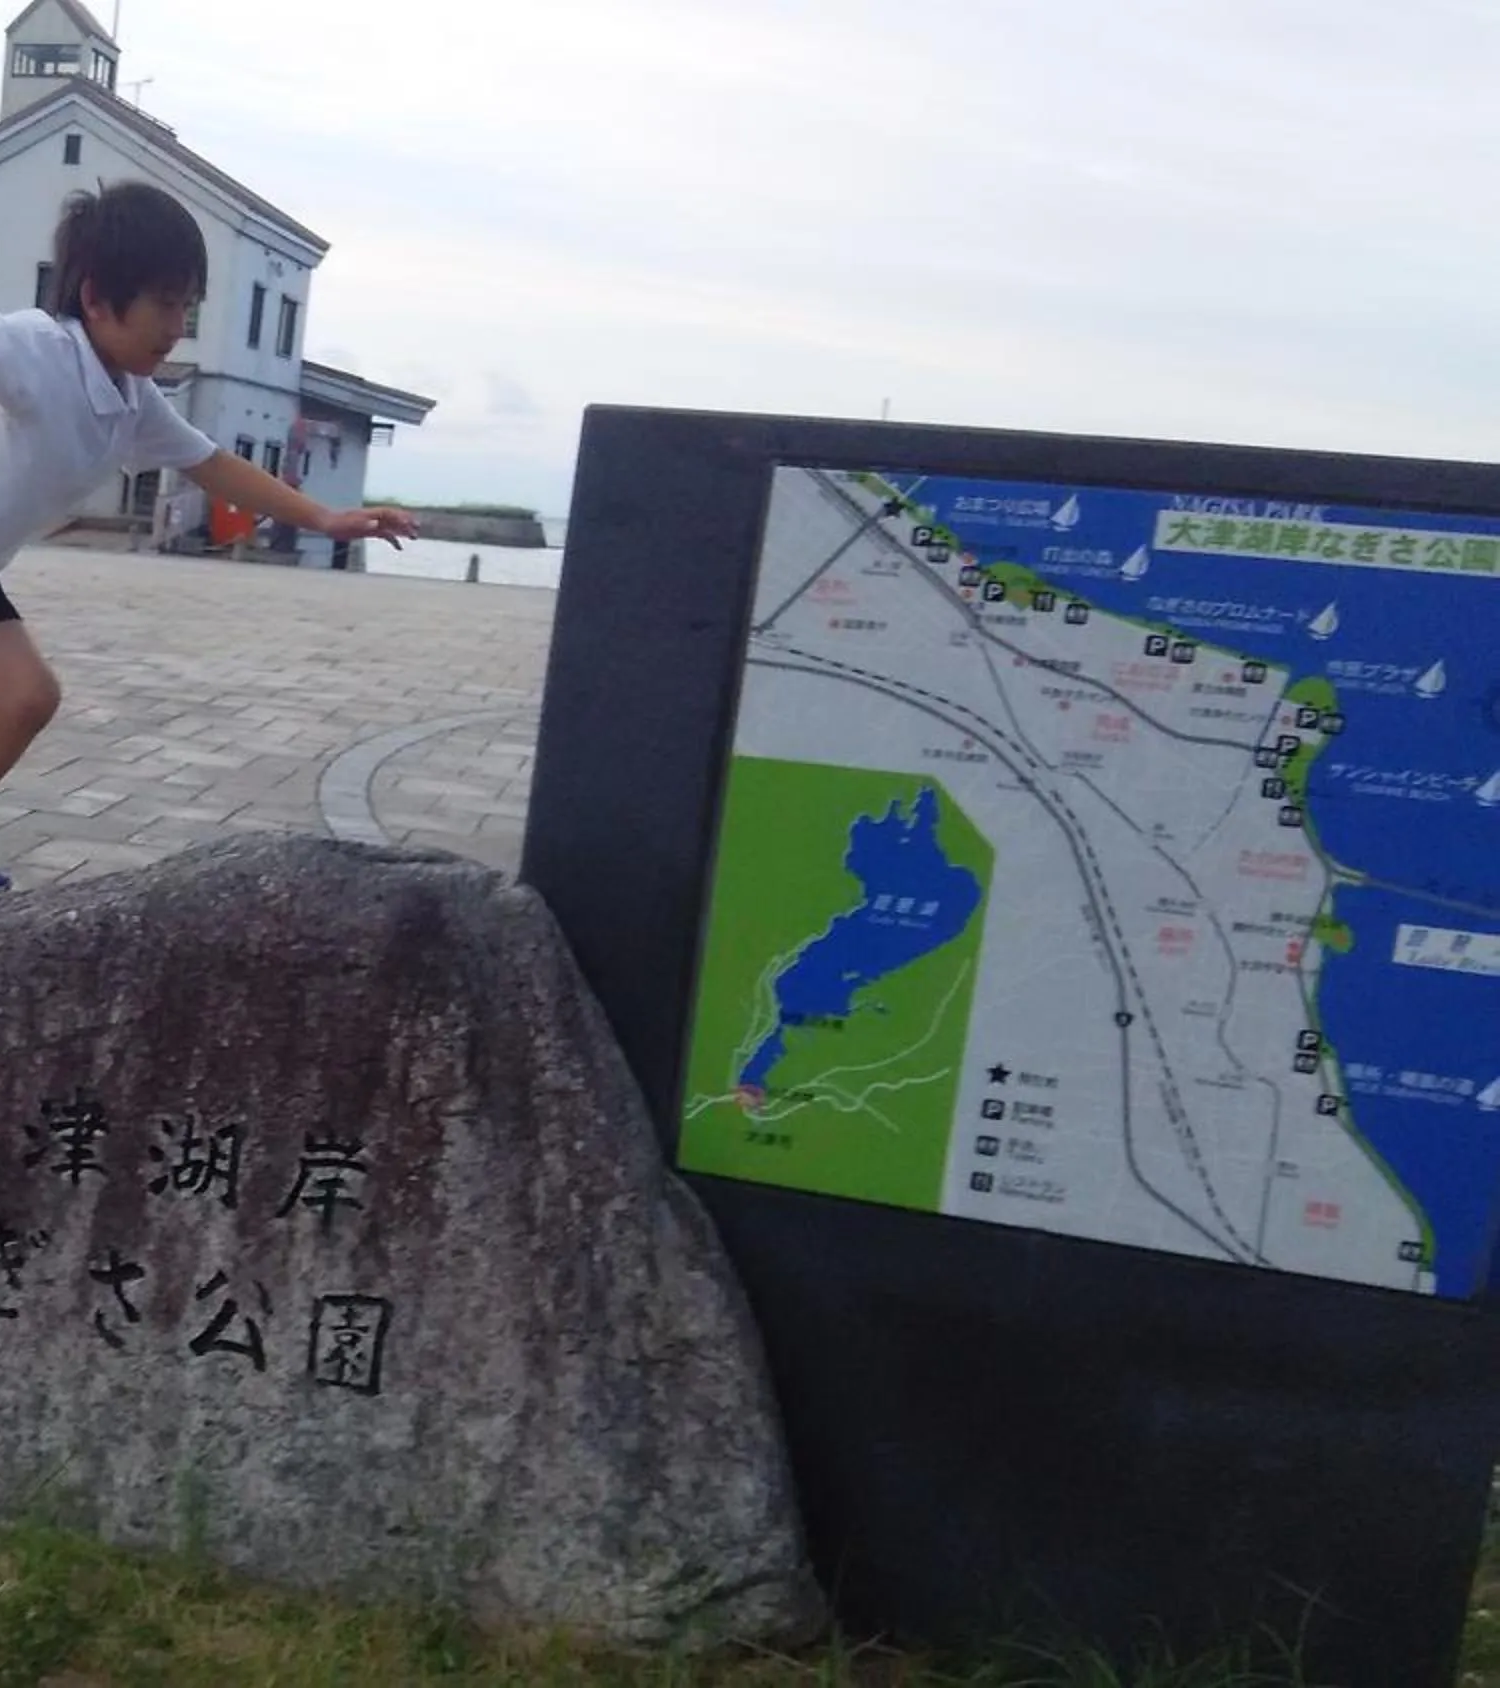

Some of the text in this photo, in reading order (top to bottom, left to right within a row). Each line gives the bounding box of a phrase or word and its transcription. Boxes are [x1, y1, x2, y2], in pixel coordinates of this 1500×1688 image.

[1165, 516, 1497, 571] 大津湖岸なぎさ公園
